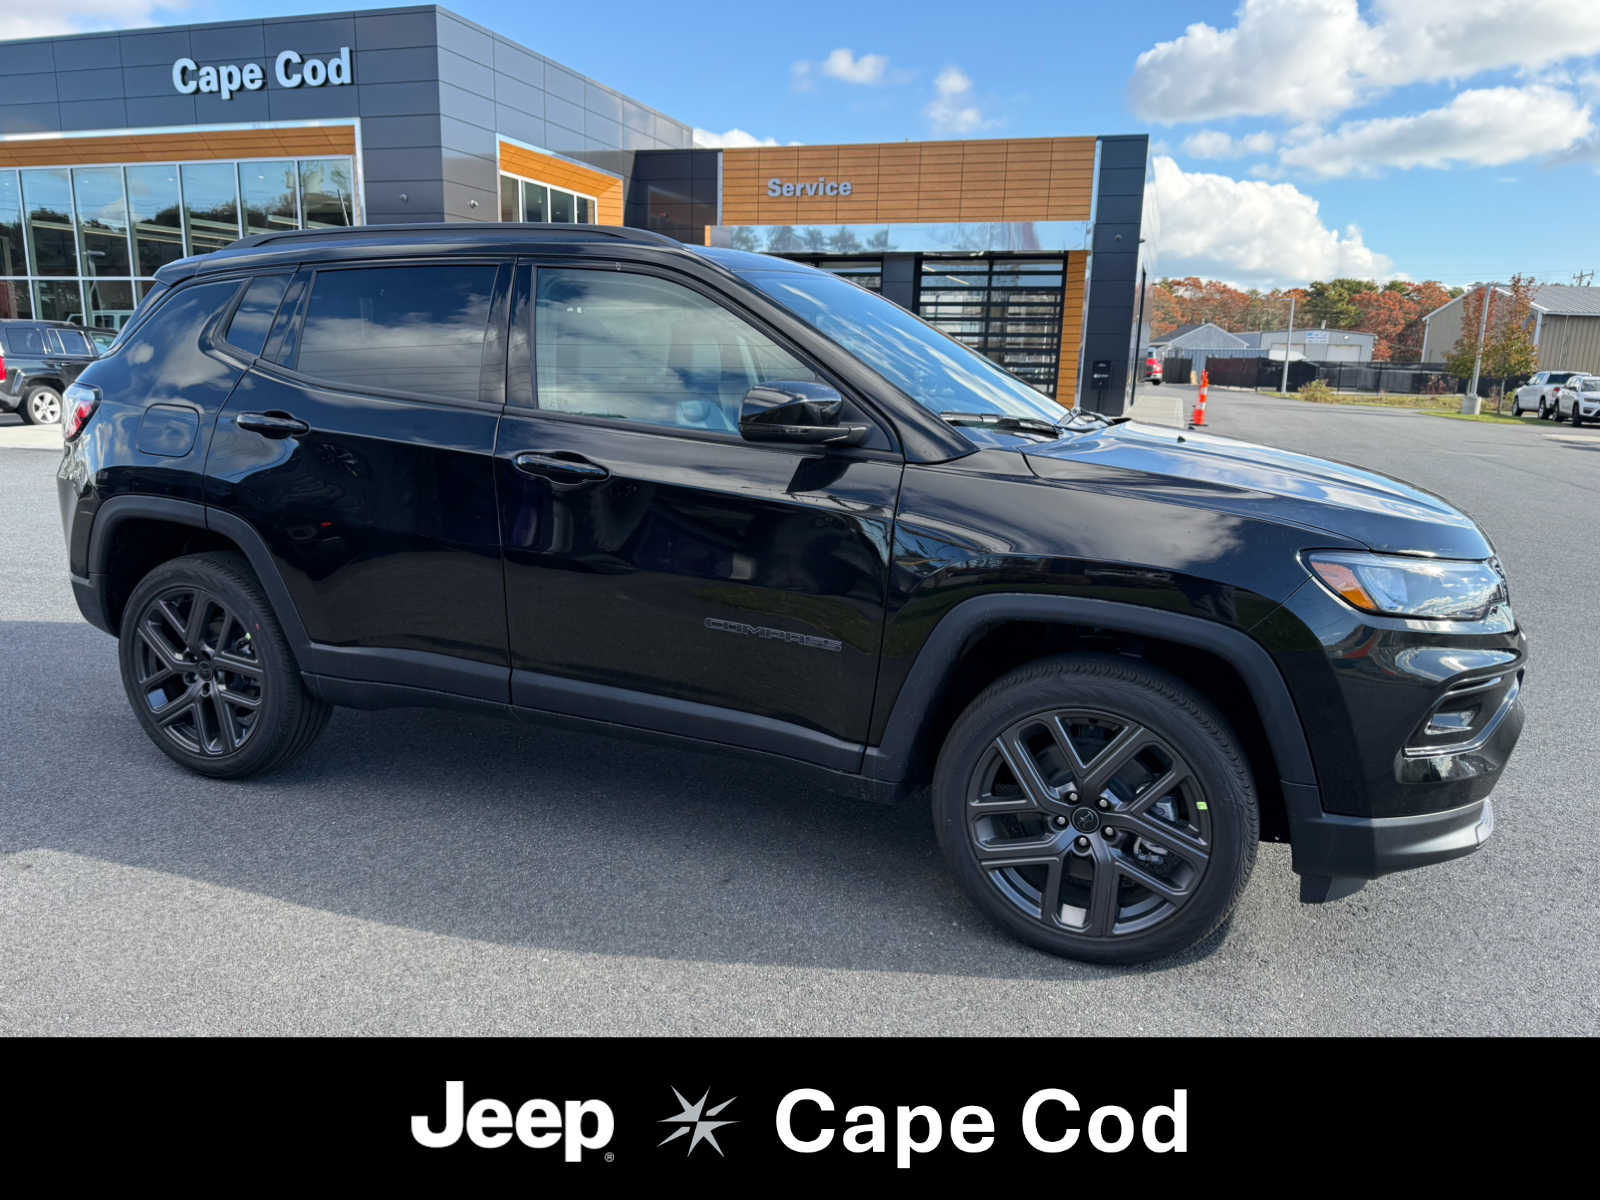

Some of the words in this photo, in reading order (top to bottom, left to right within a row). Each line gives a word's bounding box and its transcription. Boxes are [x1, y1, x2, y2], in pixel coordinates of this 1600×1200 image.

[172, 57, 264, 100] Cape
[275, 46, 352, 88] Cod
[767, 177, 852, 198] Service
[704, 617, 842, 651] COMPASS
